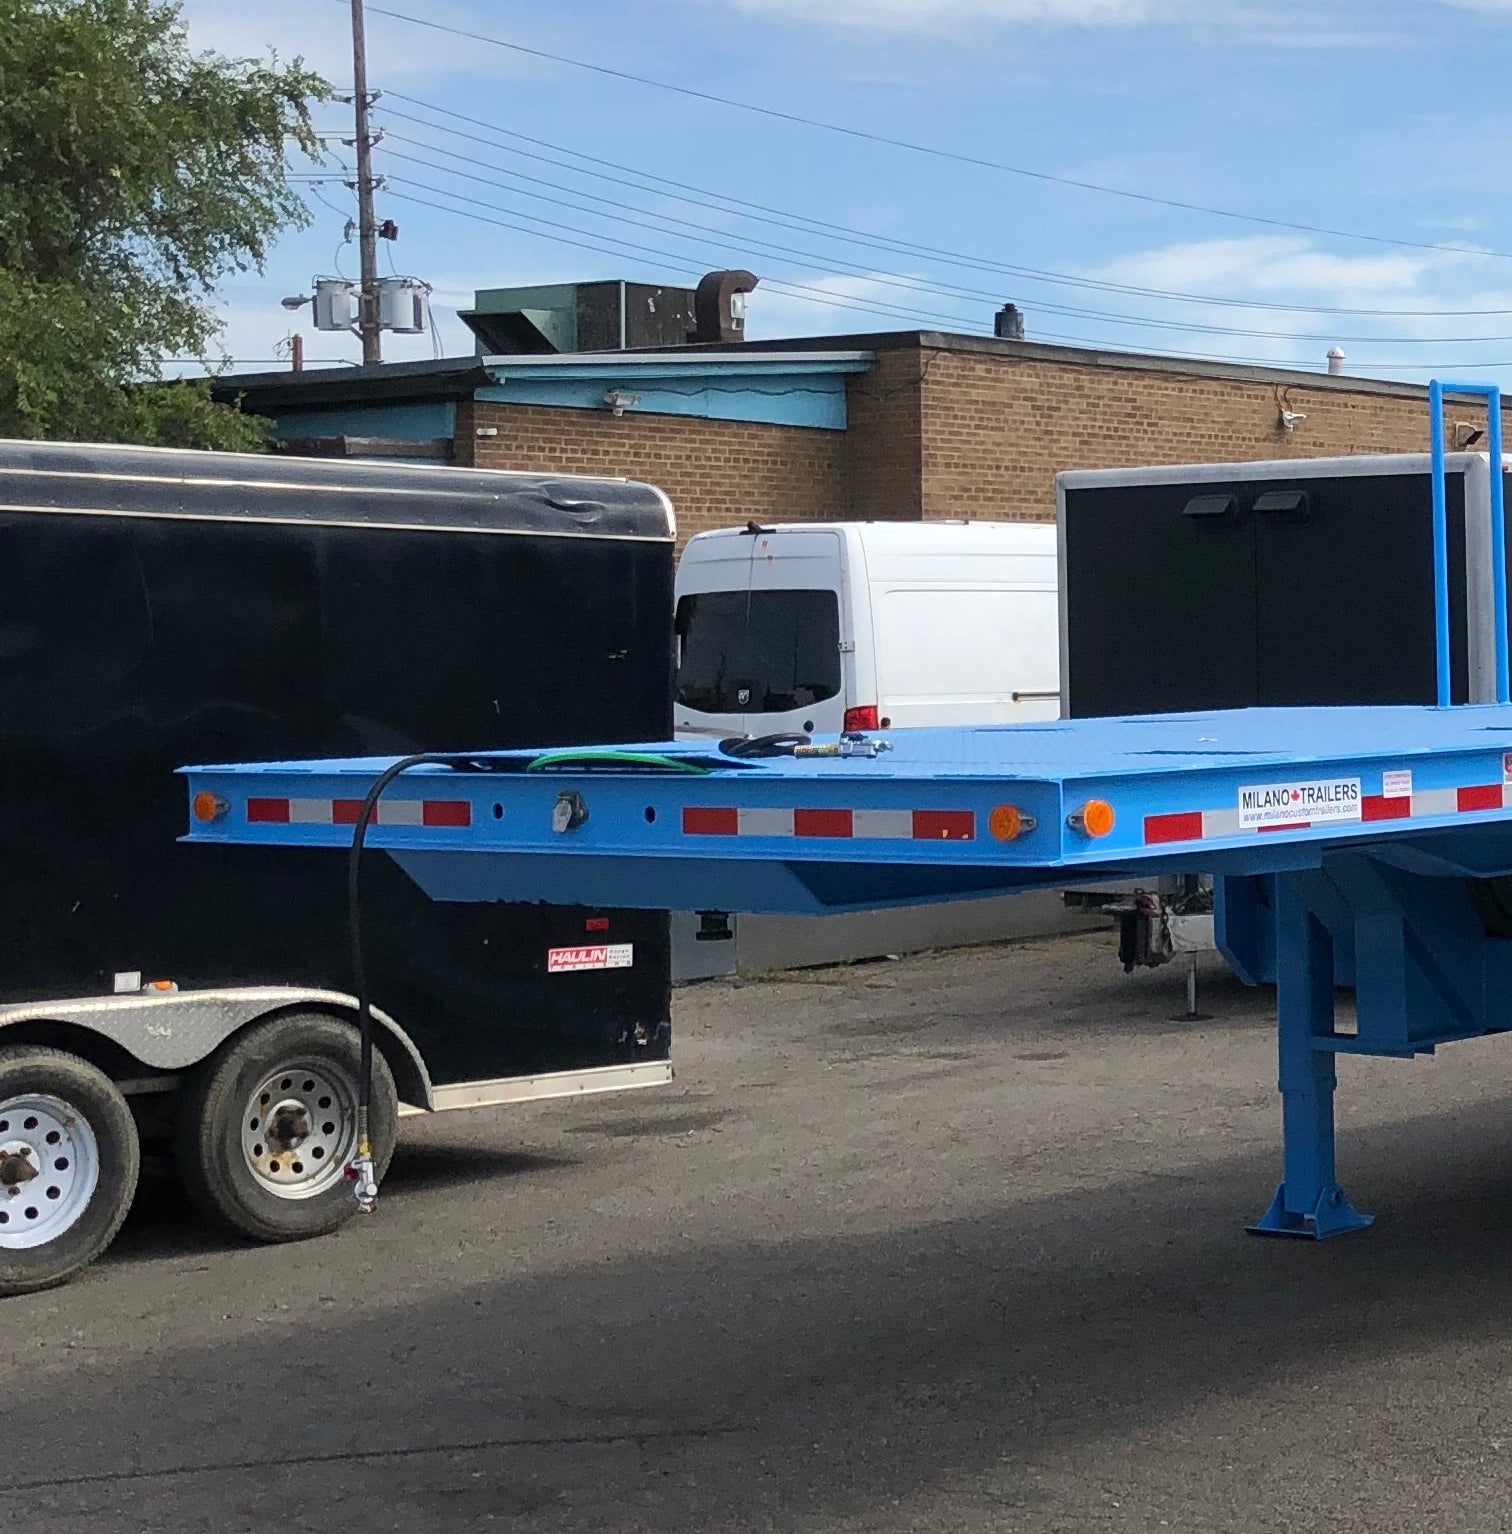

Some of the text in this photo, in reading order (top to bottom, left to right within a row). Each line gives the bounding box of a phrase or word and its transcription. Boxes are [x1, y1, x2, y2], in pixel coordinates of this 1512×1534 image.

[1242, 783, 1358, 810] MILANO TRAILERS
[1243, 803, 1358, 822] www.milanocustomtrailers.com
[550, 949, 606, 965] HAULIN
